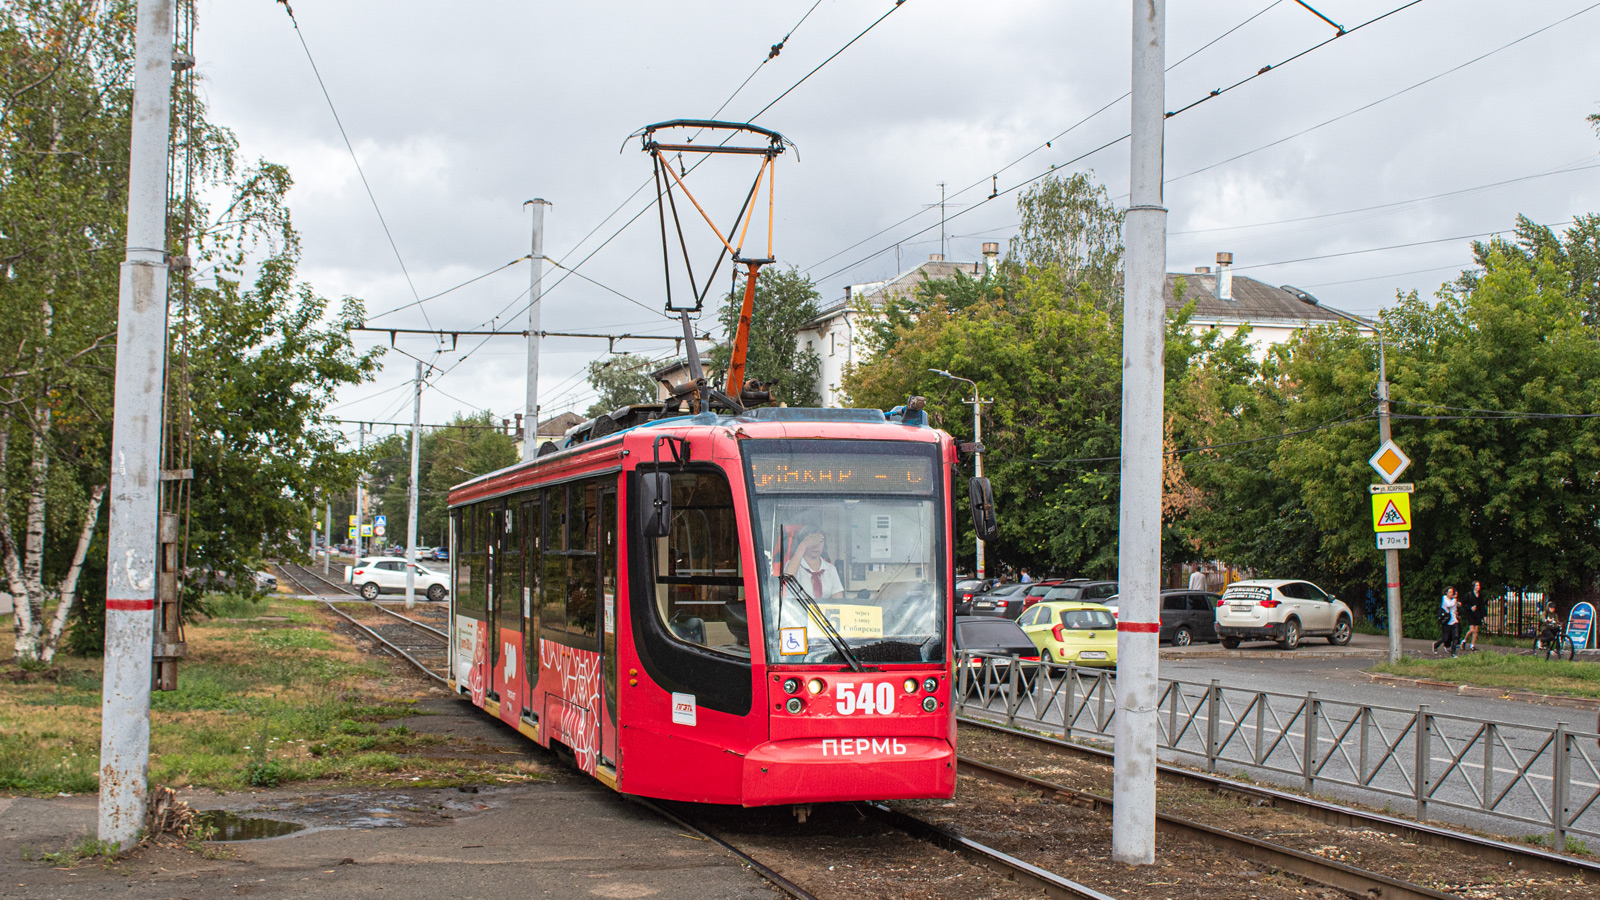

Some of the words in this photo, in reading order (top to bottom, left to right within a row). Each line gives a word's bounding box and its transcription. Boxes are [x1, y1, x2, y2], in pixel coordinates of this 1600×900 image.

[843, 624, 881, 634] Сибирская
[836, 682, 895, 715] 540
[822, 738, 907, 756] ПЕРМЬ
